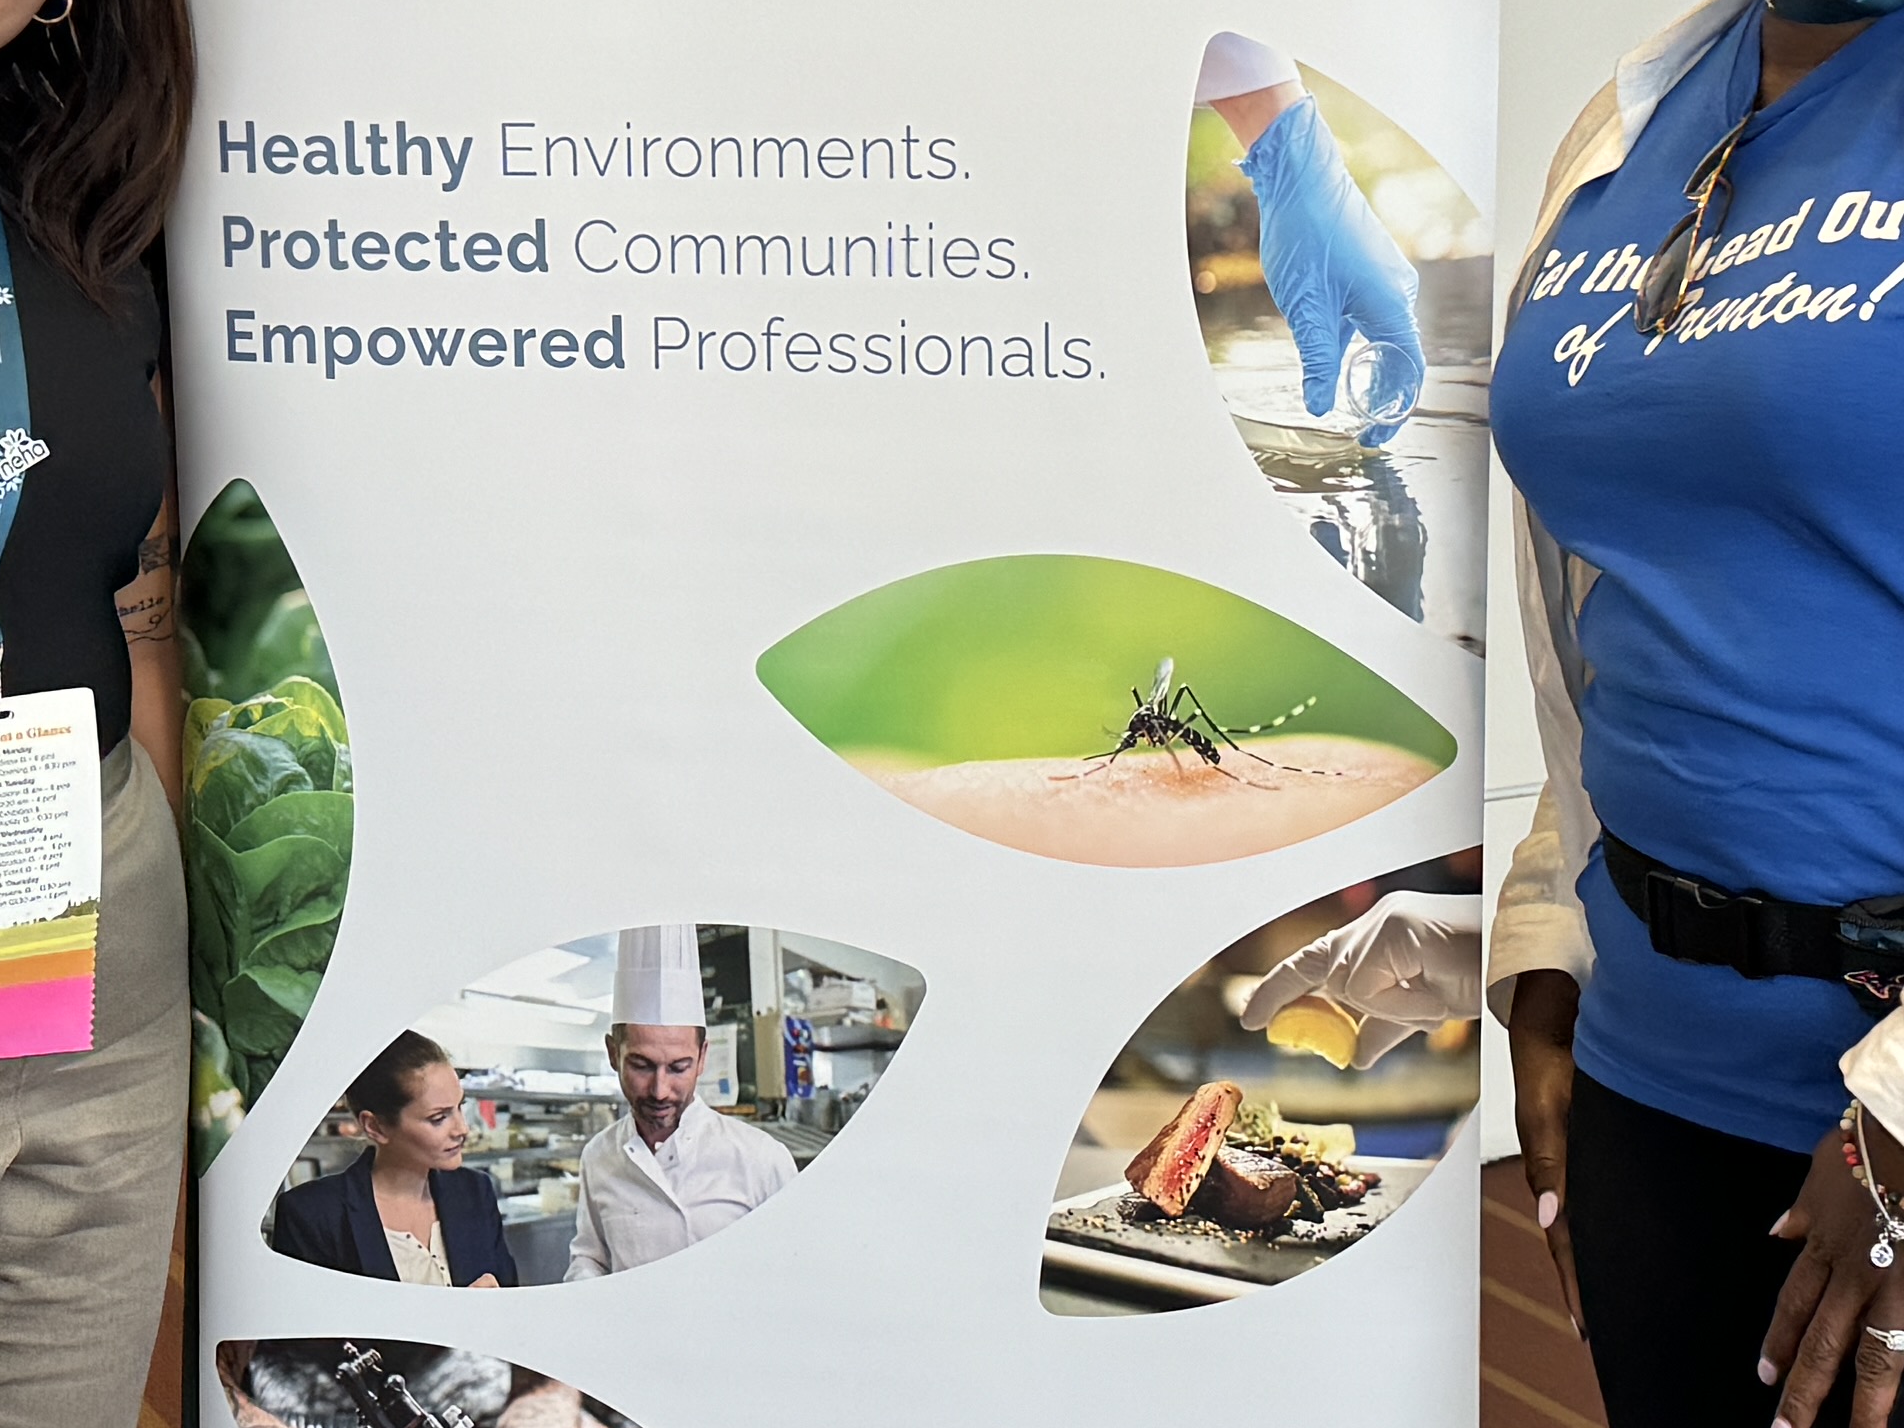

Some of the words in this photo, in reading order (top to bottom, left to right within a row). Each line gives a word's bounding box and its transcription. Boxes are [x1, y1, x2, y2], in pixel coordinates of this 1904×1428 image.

[218, 119, 474, 193] Healthy
[501, 121, 972, 181] Environments.
[222, 215, 549, 275] Protected
[574, 219, 1032, 282] Communities.
[225, 309, 626, 380] Empowered
[653, 316, 1108, 382] Professionals.
[1553, 302, 1633, 387] of
[1, 439, 46, 473] neha
